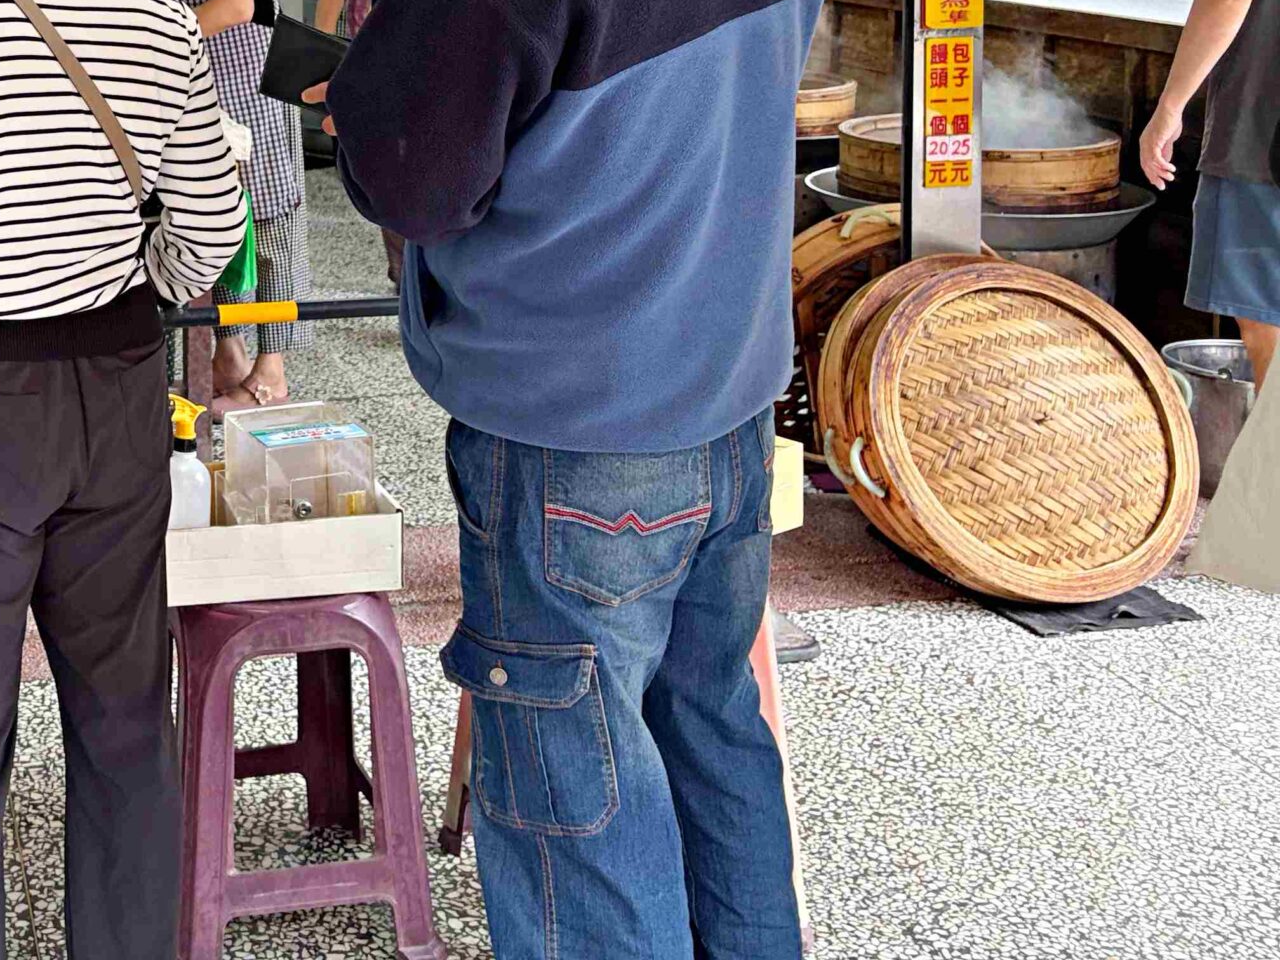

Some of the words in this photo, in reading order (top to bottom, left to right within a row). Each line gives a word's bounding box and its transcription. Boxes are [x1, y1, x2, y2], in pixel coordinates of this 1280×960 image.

[928, 43, 948, 184] 饅頭一個20元
[951, 43, 970, 183] 包子一個25元
